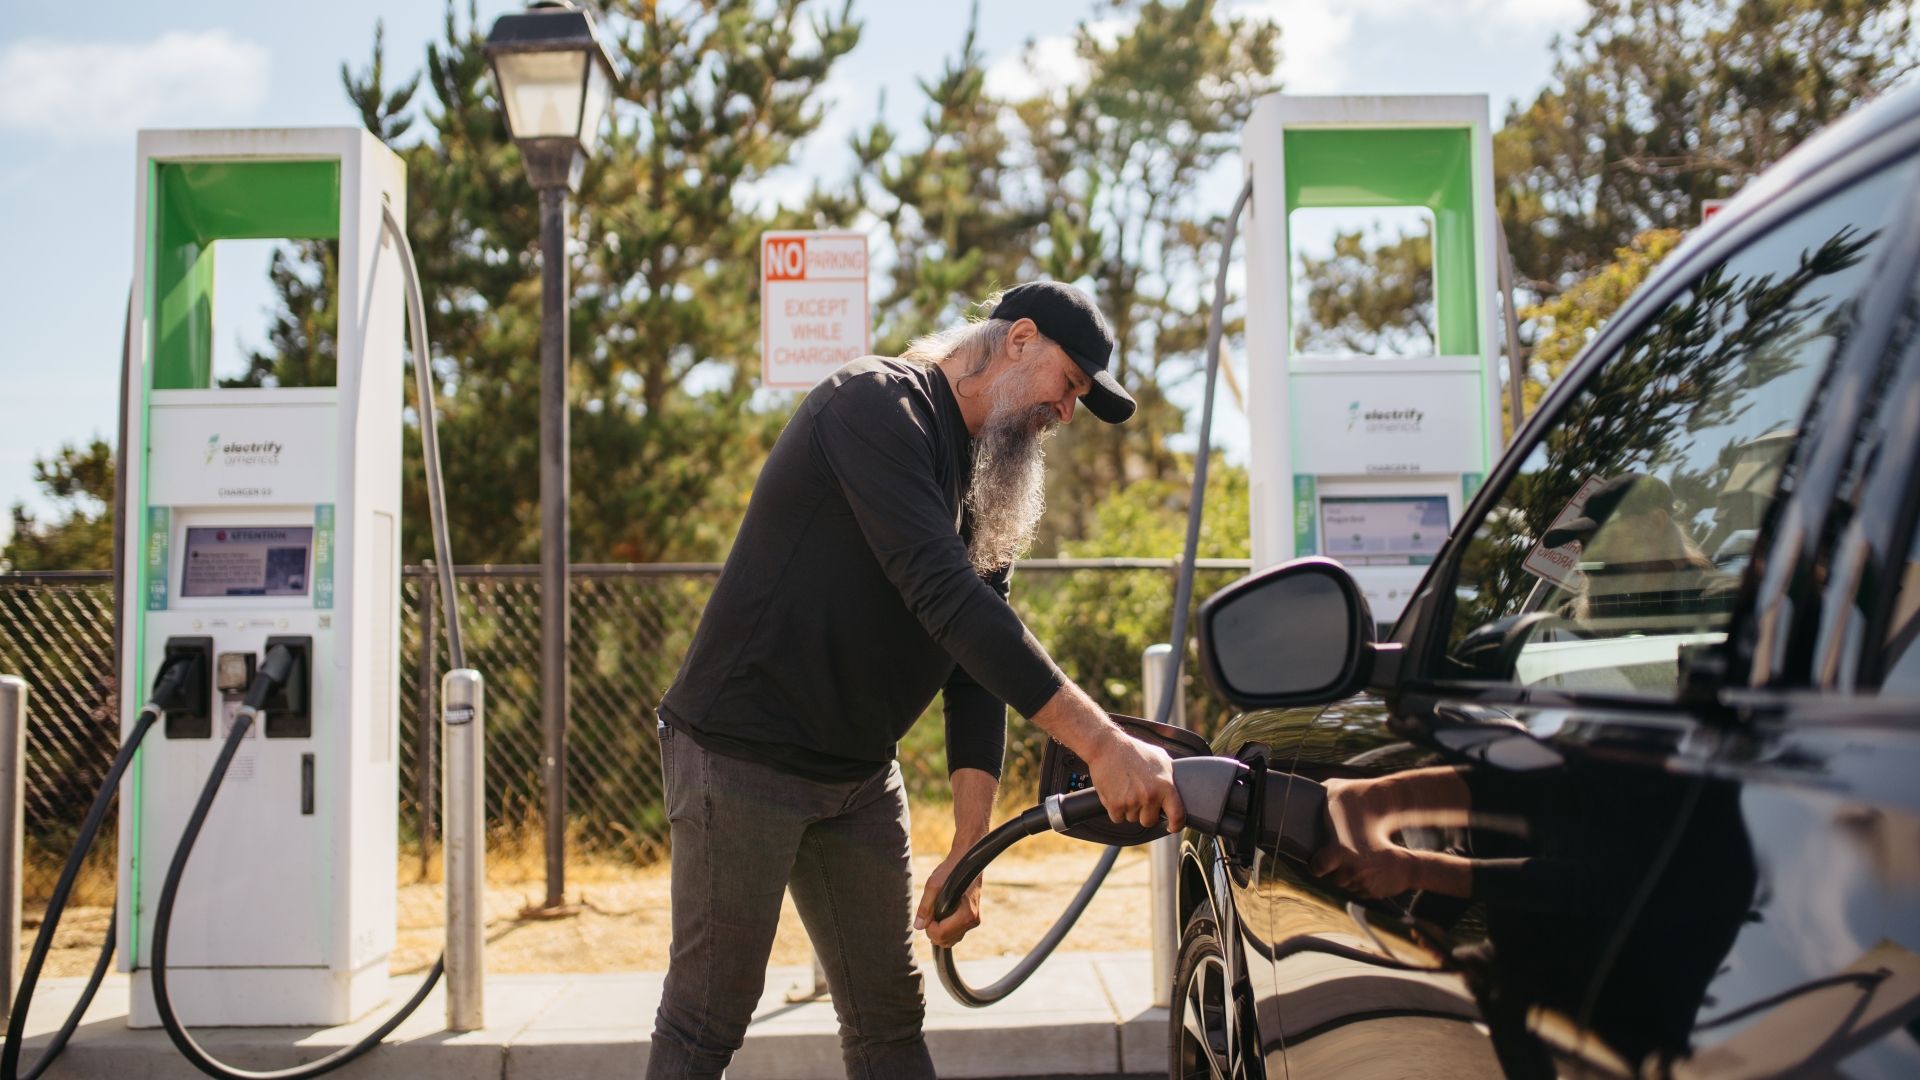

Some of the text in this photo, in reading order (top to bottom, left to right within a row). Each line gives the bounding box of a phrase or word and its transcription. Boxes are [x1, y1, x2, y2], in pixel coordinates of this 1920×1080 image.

[766, 241, 864, 277] NO PARKING
[784, 299, 848, 318] EXCEPT
[792, 323, 842, 341] WHILE
[1365, 408, 1424, 423] electrify
[223, 440, 282, 455] electrify
[224, 455, 280, 465] america
[218, 487, 259, 497] CHARGER
[231, 530, 287, 542] ATTENTION
[150, 532, 162, 565] Ultra
[318, 530, 329, 563] Ultra
